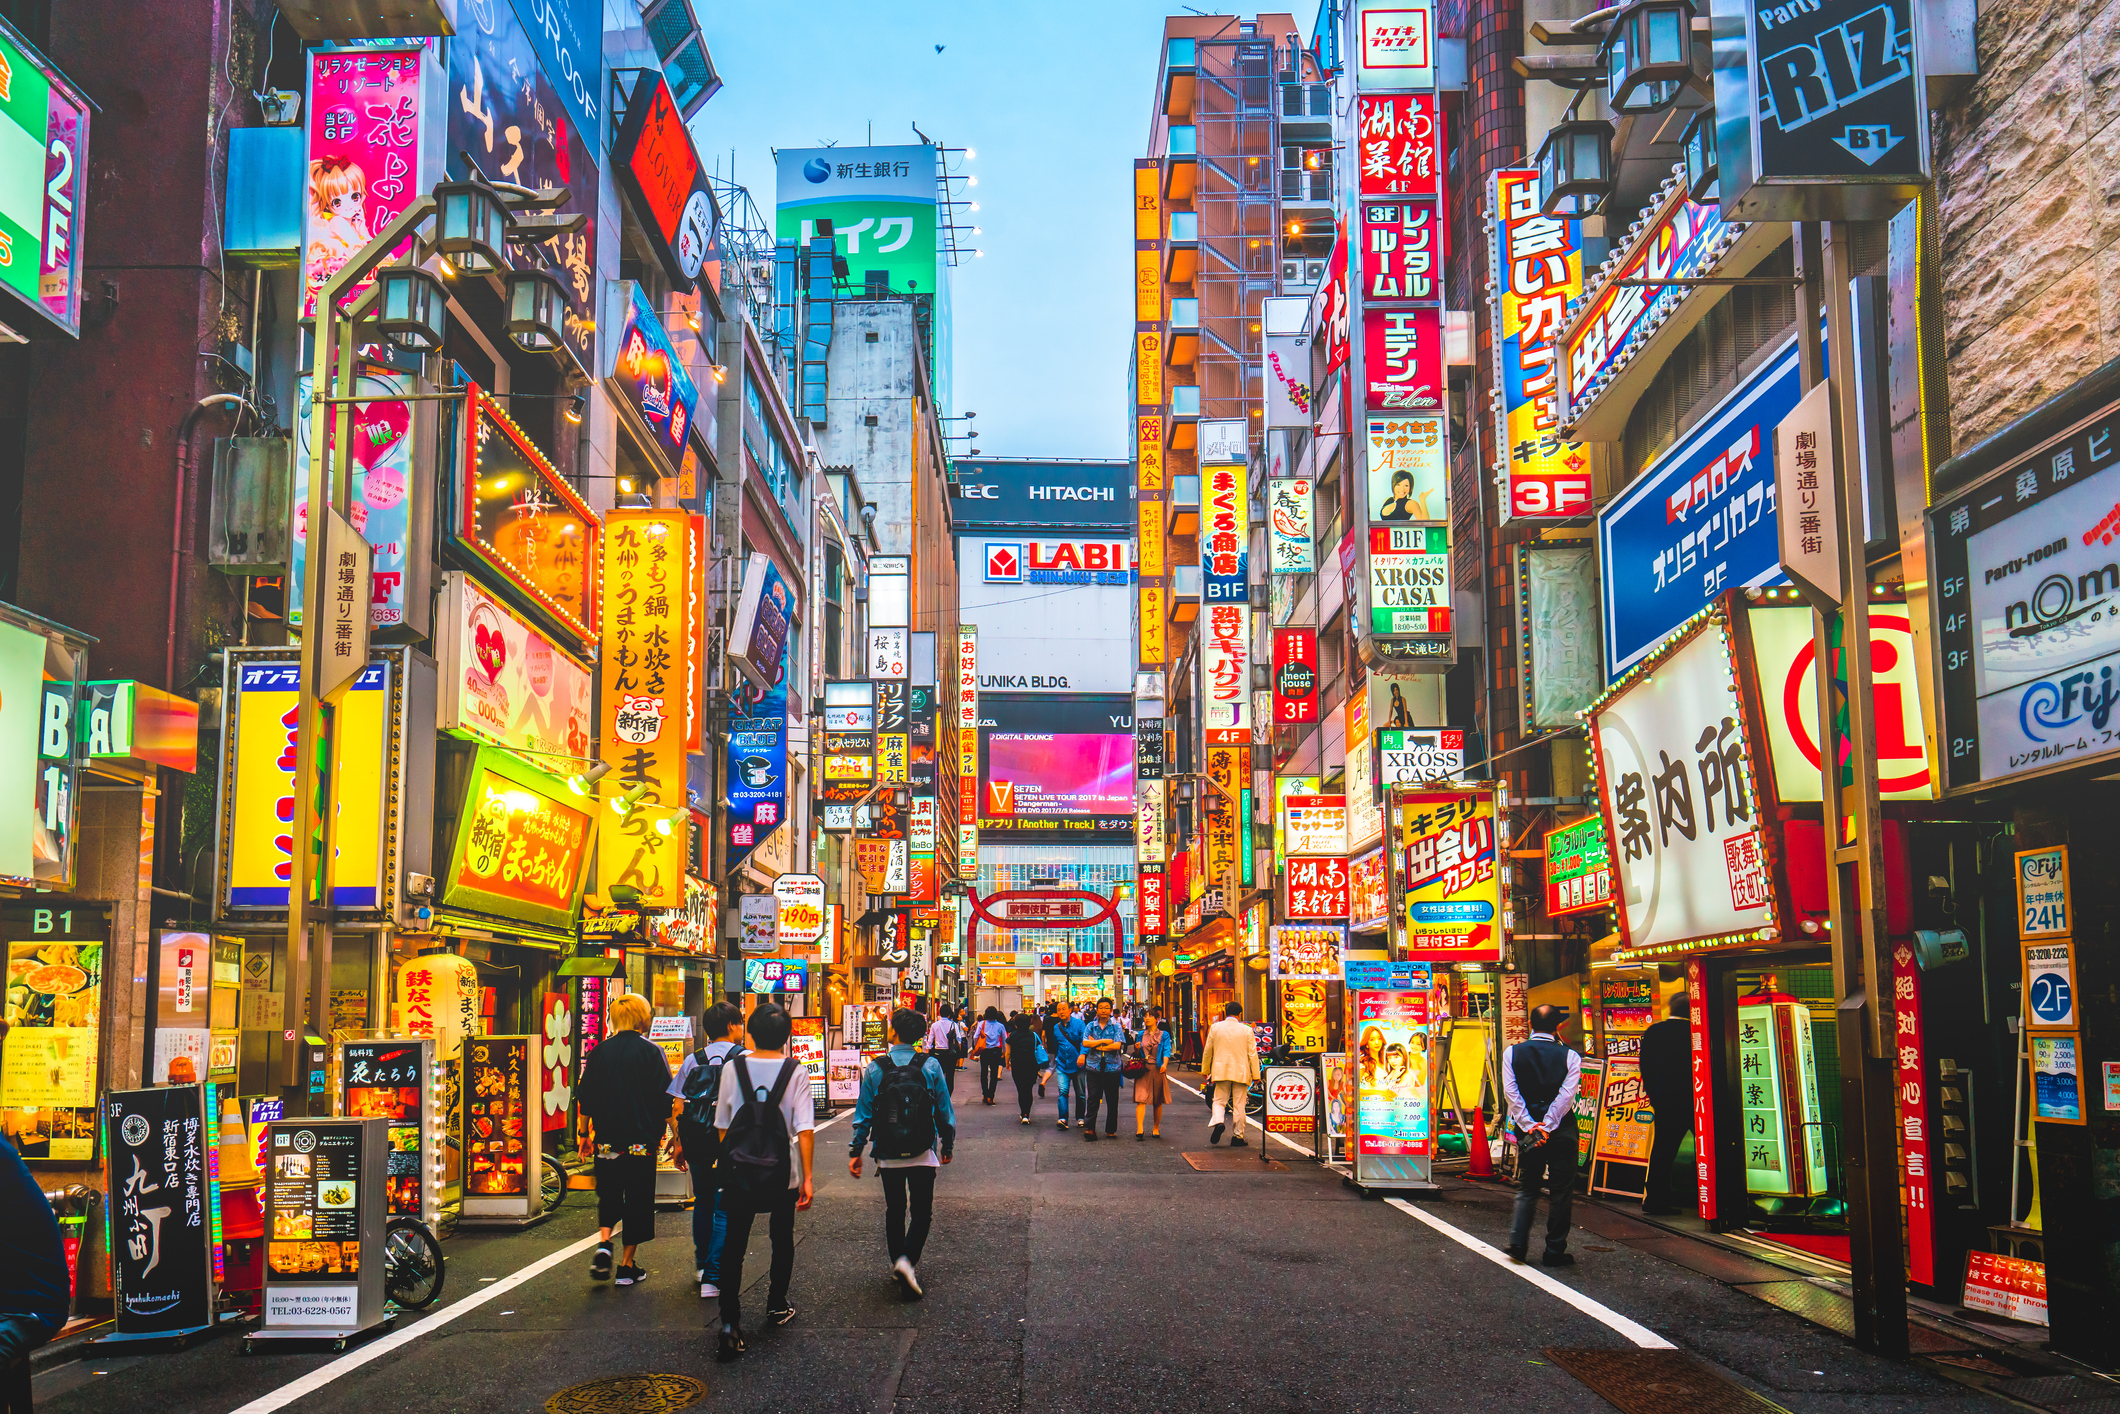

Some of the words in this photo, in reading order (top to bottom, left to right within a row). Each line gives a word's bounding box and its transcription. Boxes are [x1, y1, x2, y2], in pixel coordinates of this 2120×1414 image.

[1759, 0, 1821, 30] Party
[1369, 36, 1421, 47] ラウンジ
[1376, 26, 1416, 36] カブキ
[318, 57, 416, 73] リラクゼーション
[1761, 4, 1905, 131] RIZ
[338, 79, 395, 94] リゾート
[325, 112, 357, 126] 当ビル
[1361, 98, 1433, 140] 湖南
[324, 127, 353, 140] 6F
[1850, 128, 1888, 148] B1
[837, 161, 910, 179] 新生銀行
[1362, 140, 1434, 179] 菜館
[642, 124, 682, 222] CLOVER
[1386, 180, 1411, 193] 4F
[47, 139, 73, 268] 2F
[1371, 207, 1395, 222] 3F
[1403, 205, 1432, 297] レンタル
[1371, 229, 1400, 297] ルーム
[564, 304, 590, 350] 0916
[1384, 312, 1418, 383] エデン
[1382, 385, 1437, 408] Eden
[1386, 421, 1438, 434] タイ古式
[1371, 435, 1439, 448] マッサージ
[1142, 453, 1160, 486] 魚金
[1672, 428, 1753, 523] マクロス
[1029, 486, 1115, 501] HITACHI
[1795, 431, 1822, 555] 劇場通り一番街
[1950, 428, 2112, 537] 第一桑原ビ
[1515, 480, 1586, 513] 3F
[1212, 471, 1239, 577] まぐろ商店
[1393, 530, 1423, 549] B1F
[1653, 480, 1777, 593] オンラインカフェ
[1029, 542, 1125, 570] LABI
[1985, 536, 2068, 585] Party-room
[1030, 571, 1092, 584] SHINJUKU
[1374, 568, 1445, 587] XROSS
[1704, 561, 1727, 597] 2F
[1944, 577, 1964, 598] 5F
[1208, 582, 1244, 598] B1F
[1382, 588, 1437, 606] CASA
[334, 552, 357, 657] 劇場通り一番街
[614, 526, 640, 691] 九州のうまかもん
[1146, 605, 1160, 662] すずや
[1945, 614, 1967, 632] 4F
[643, 625, 671, 694] 水炊き
[874, 635, 890, 672] 桜島
[1208, 606, 1248, 701] 熟女キャバクラ
[1381, 643, 1450, 655] 第一大滝ビル
[1948, 651, 1969, 670] 3F
[961, 641, 975, 720] お好み焼き
[977, 675, 1028, 688] UNIKA
[1032, 676, 1071, 688] BLDG.
[1284, 664, 1315, 680] meat
[467, 676, 488, 699] 40min
[1281, 676, 1311, 696] house
[1285, 702, 1308, 719] 3F
[618, 711, 658, 734] 新宿
[732, 717, 784, 732] GREAT
[737, 732, 778, 747] BLUE
[1218, 730, 1240, 742] 4F
[1953, 738, 1974, 757] 2F
[886, 736, 903, 767] 麻雀
[962, 730, 974, 774] 麻雀ブル
[1387, 752, 1459, 768] XROSS
[829, 765, 861, 773] クアトロ
[886, 769, 904, 782] 2F
[1396, 768, 1452, 782] CASA
[1014, 785, 1041, 793] SE7EN
[1107, 795, 1128, 803] Japan
[1615, 716, 1753, 864] 案内所
[1410, 794, 1478, 837] キラリ
[1408, 816, 1491, 887] 出会い
[1549, 821, 1605, 859] レンタルルーム
[503, 835, 570, 899] まっちゃん
[1292, 859, 1346, 889] 湖南
[1443, 856, 1495, 899] カフェ
[1292, 890, 1333, 915] 菜館
[2025, 890, 2064, 904] 年中無休
[784, 908, 819, 924] 190円
[1010, 904, 1081, 915] 歌舞伎町一番街
[2026, 904, 2066, 931] 24H
[1416, 935, 1469, 949] 受付3F
[1603, 982, 1640, 998] レンタルルーム
[2036, 979, 2068, 1011] 2F
[1607, 1038, 1641, 1056] 出会い
[349, 1060, 417, 1084] 花たろう
[1272, 1092, 1309, 1100] ラウンジ
[1276, 1084, 1305, 1092] カブキ
[1739, 1024, 1770, 1168] 無料案内所
[1896, 976, 1926, 1209] 絶対安心宣言!!
[1268, 1123, 1313, 1132] COFFEE
[163, 1119, 180, 1189] 新宿東口店
[1971, 1255, 2045, 1278] ここにごみを
[1964, 1295, 1995, 1307] garbage
[1998, 1301, 2019, 1312] here.
[1965, 1285, 1991, 1296] Please
[1993, 1291, 2004, 1299] do
[2007, 1295, 2020, 1303] not
[2023, 1297, 2048, 1309] throw
[271, 1306, 352, 1316] TEL:03-6228-0567
